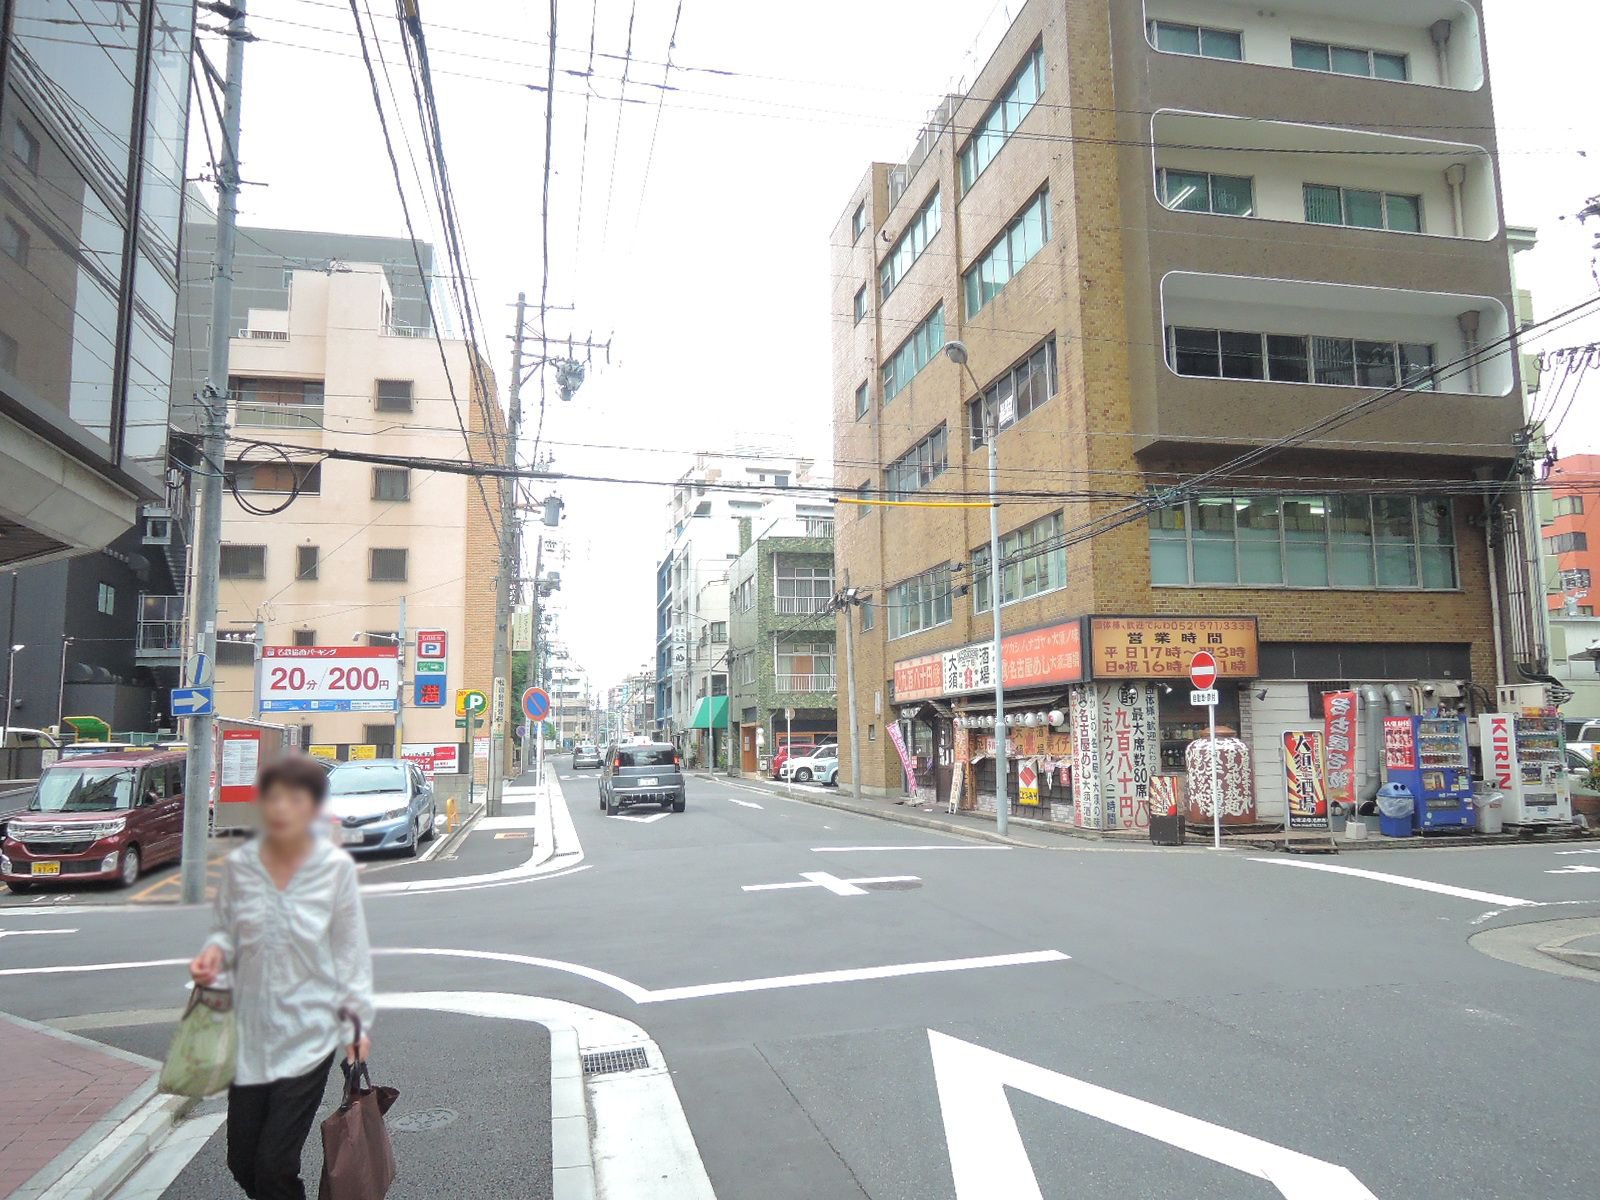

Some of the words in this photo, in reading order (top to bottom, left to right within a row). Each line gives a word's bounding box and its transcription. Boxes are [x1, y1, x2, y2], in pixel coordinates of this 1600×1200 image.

[425, 644, 437, 653] P
[1127, 632, 1223, 645] 営業時間
[948, 656, 958, 689] 大須
[979, 647, 990, 685] 酒場
[1115, 707, 1133, 817] 九百八十円
[1132, 707, 1148, 798] 最大席数80席
[1491, 718, 1512, 790] KIRIN
